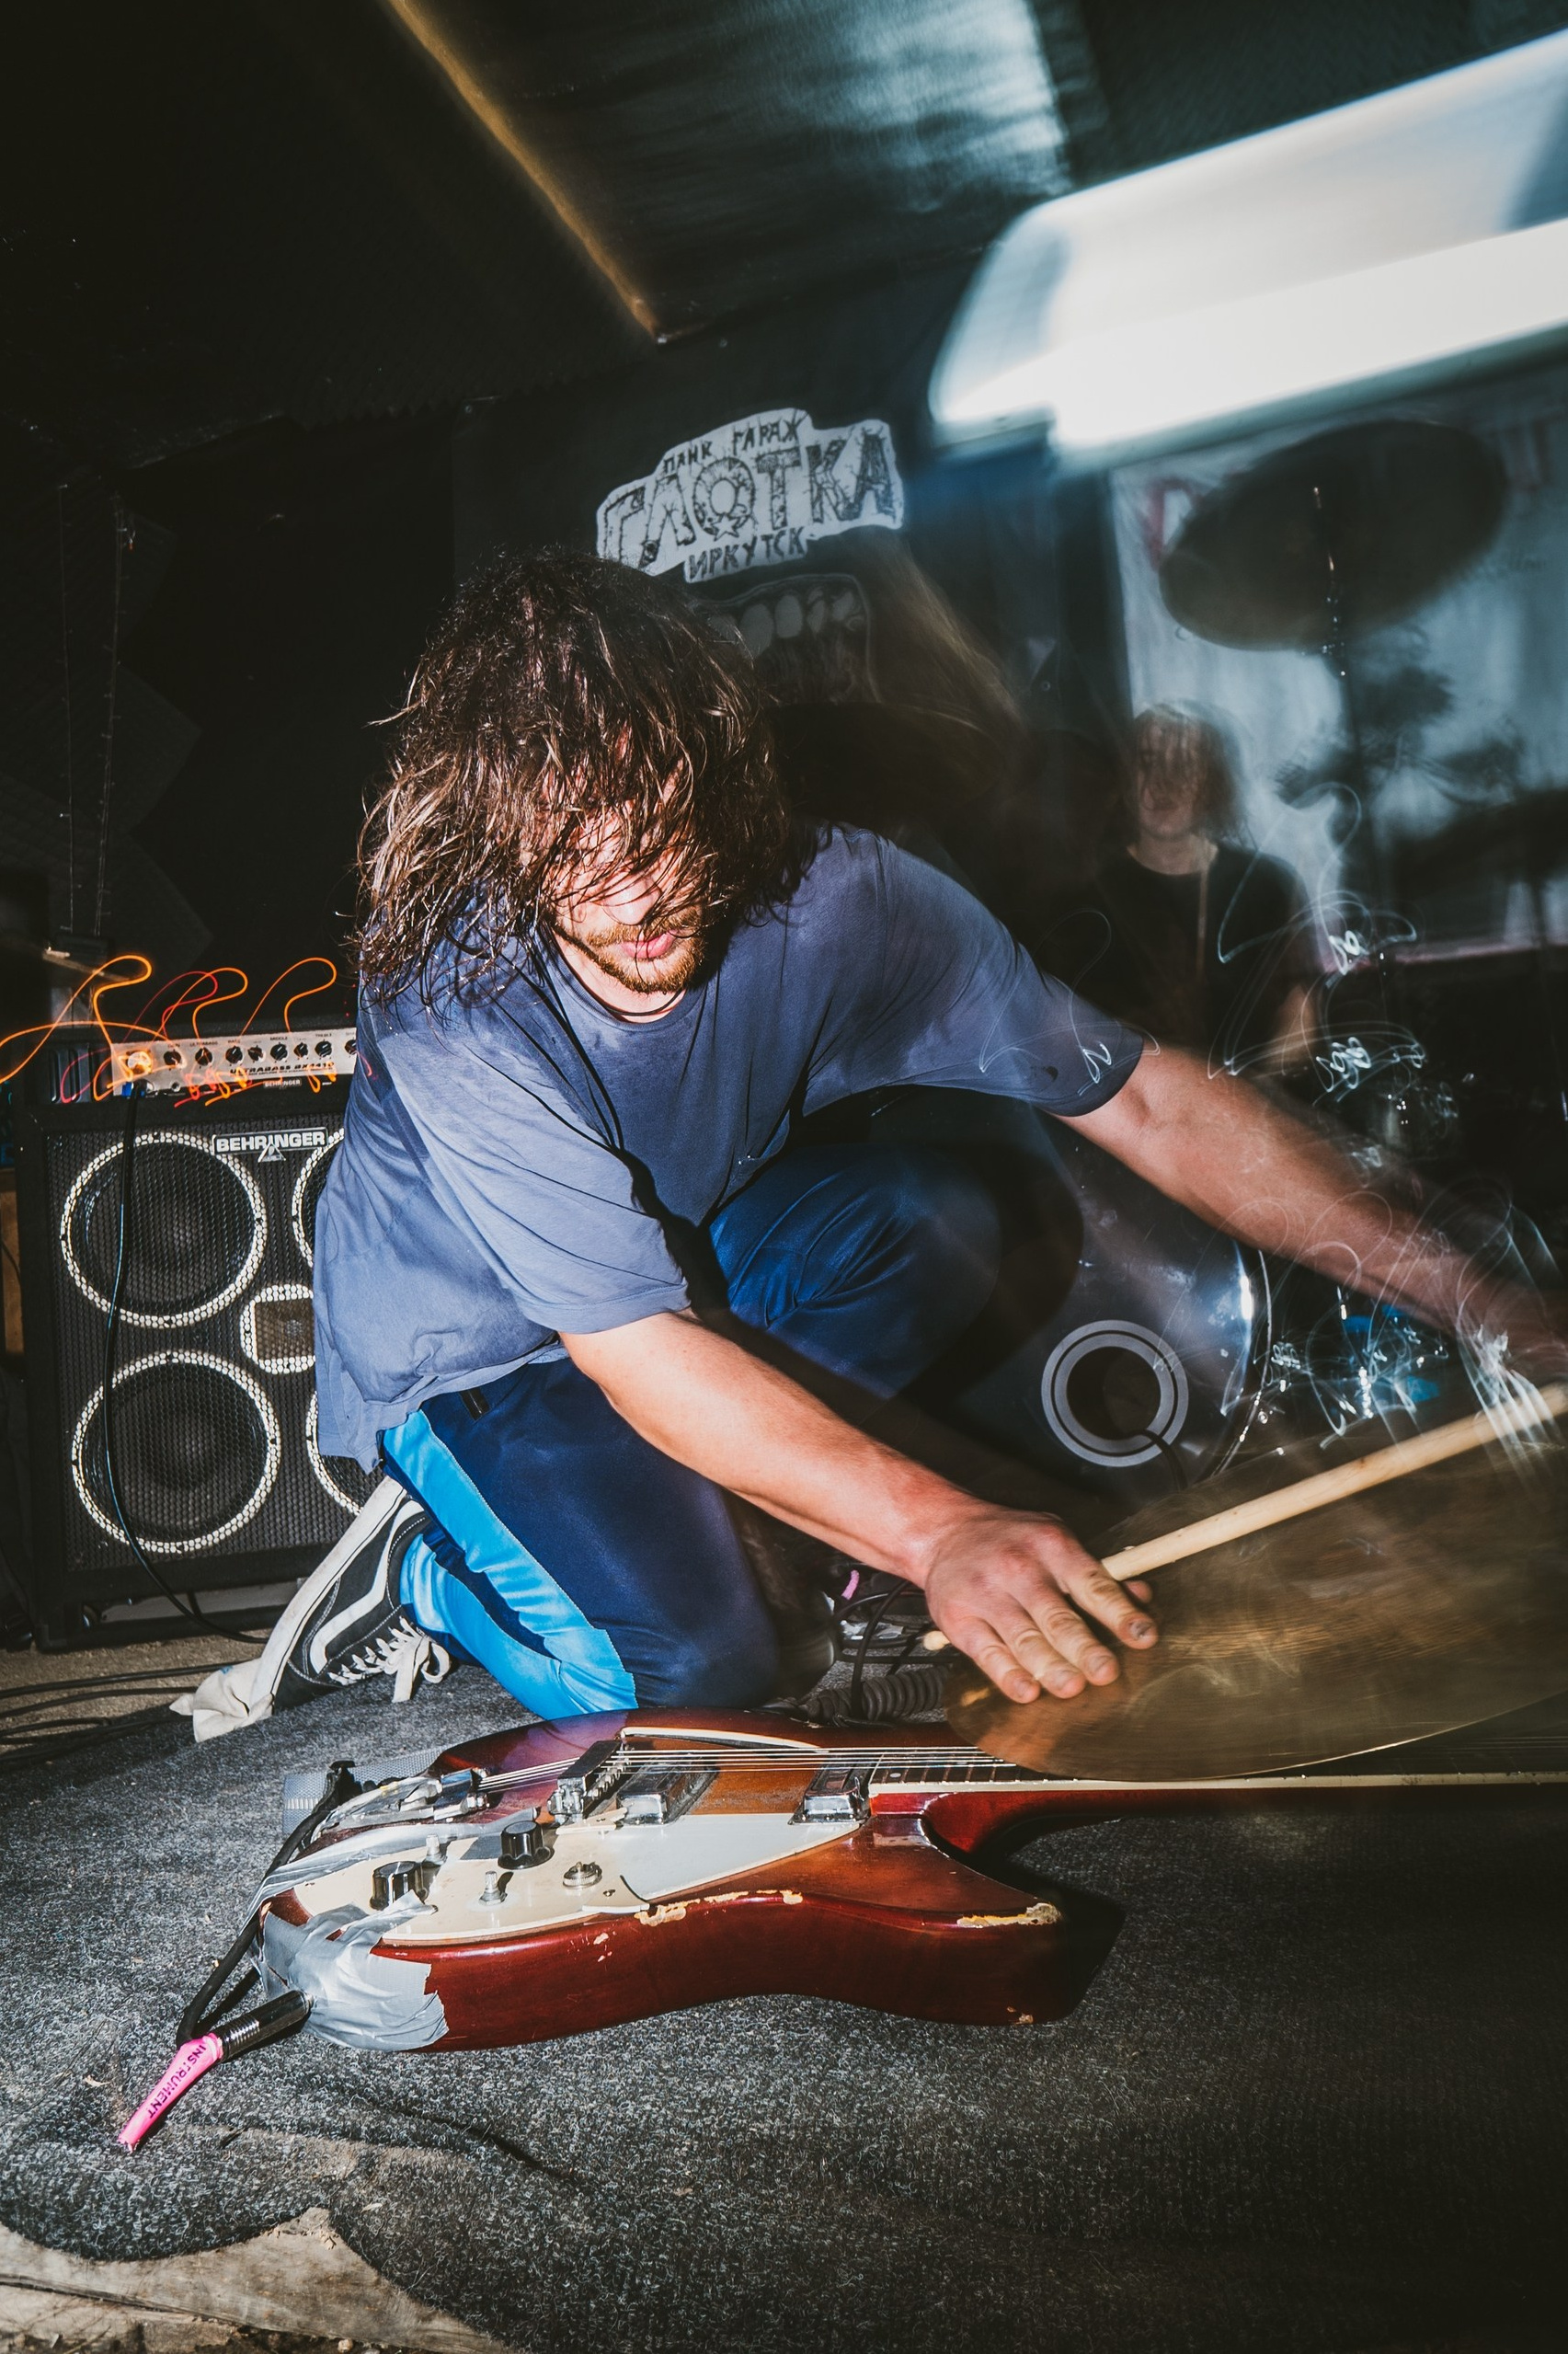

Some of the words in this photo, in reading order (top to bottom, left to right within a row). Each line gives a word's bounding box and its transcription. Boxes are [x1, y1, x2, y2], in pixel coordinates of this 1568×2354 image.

[662, 441, 713, 475] ПАНК
[731, 414, 804, 453] ГАРАЖ
[603, 431, 898, 569] ГЛОТКА
[689, 527, 807, 580] ИРКУТСК
[216, 1131, 326, 1153] BEHRINGER
